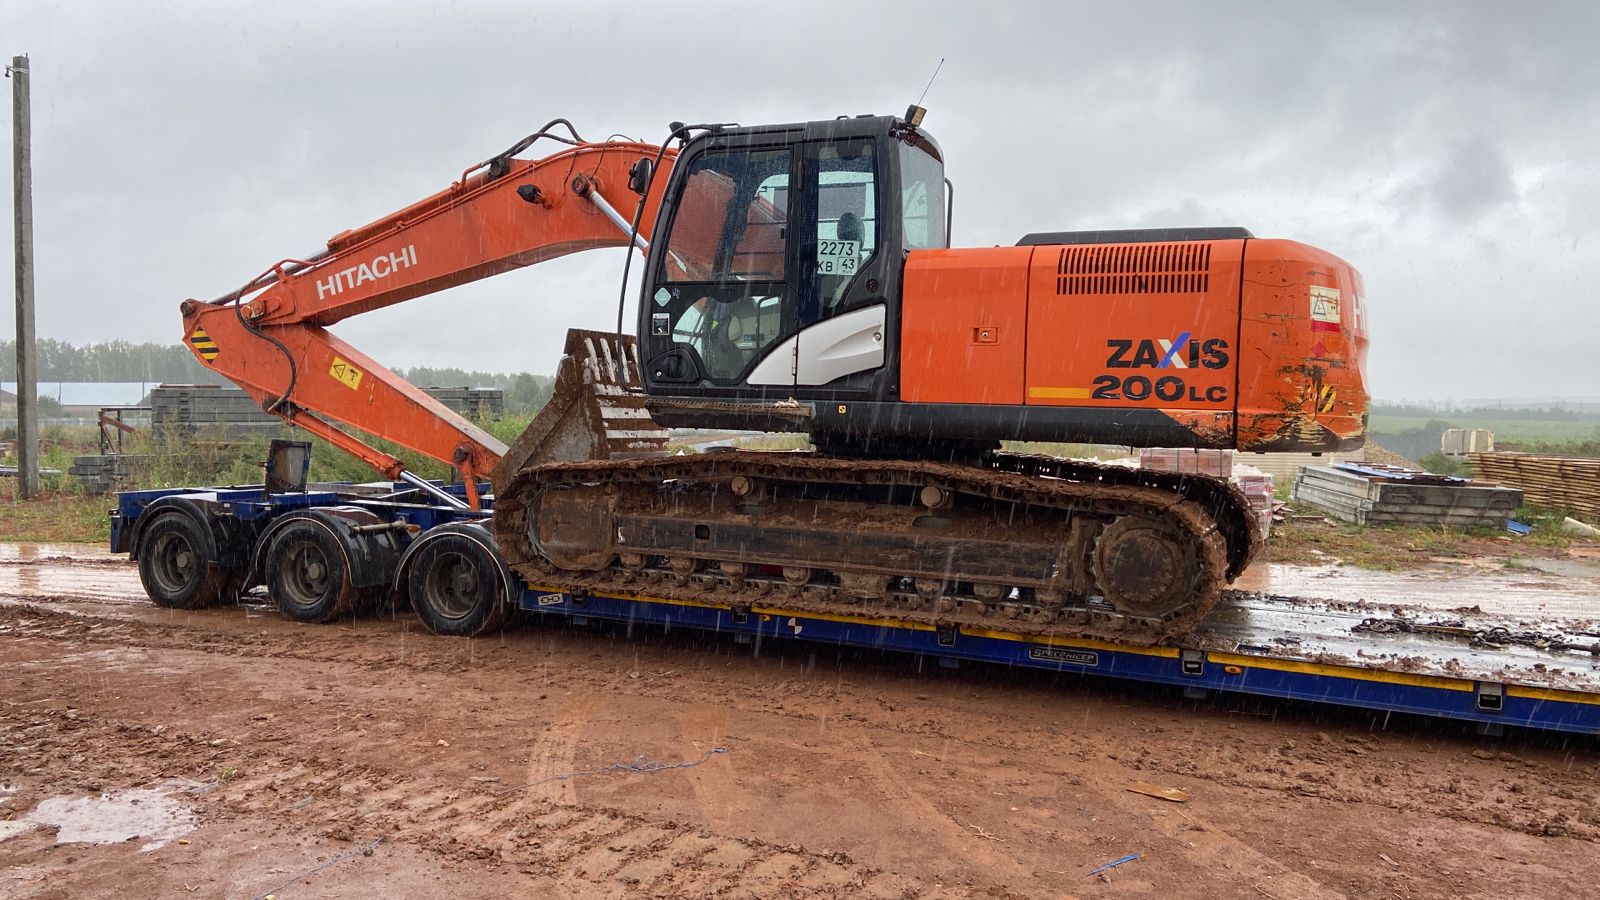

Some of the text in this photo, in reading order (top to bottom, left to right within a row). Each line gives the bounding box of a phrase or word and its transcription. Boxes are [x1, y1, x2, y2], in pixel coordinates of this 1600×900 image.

[820, 241, 854, 256] 2273
[316, 244, 418, 300] HITACHI
[842, 259, 854, 269] 43
[1106, 332, 1229, 369] ZAXIS
